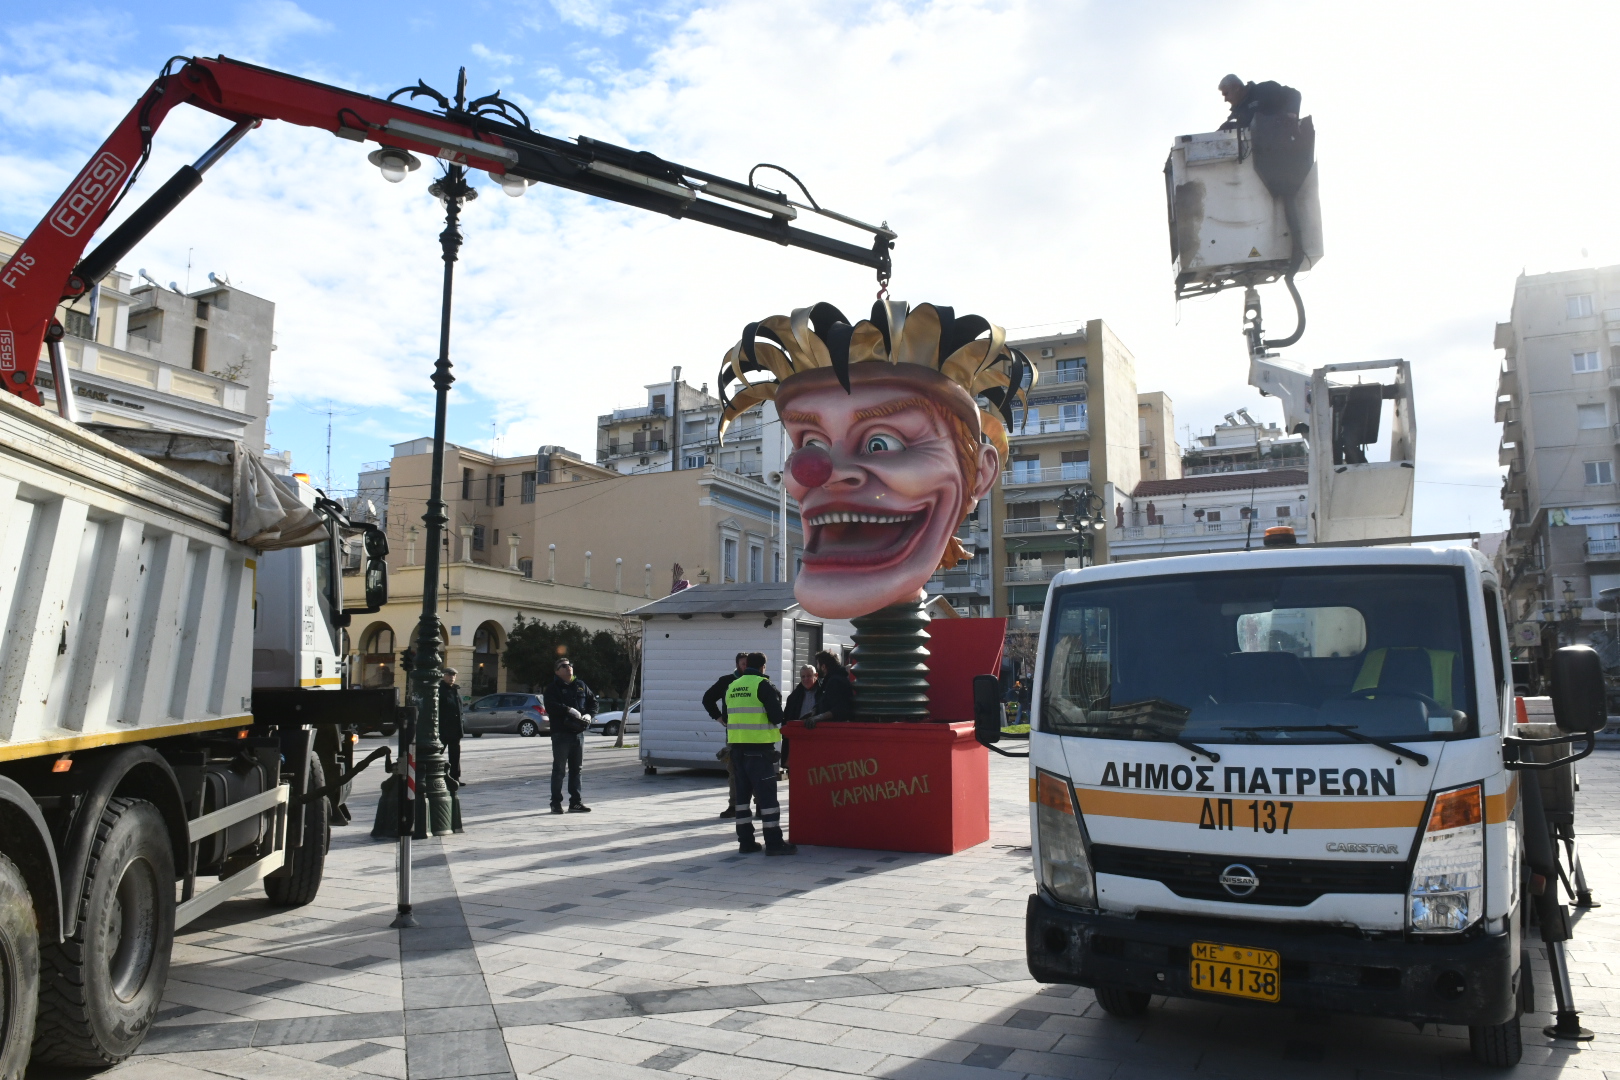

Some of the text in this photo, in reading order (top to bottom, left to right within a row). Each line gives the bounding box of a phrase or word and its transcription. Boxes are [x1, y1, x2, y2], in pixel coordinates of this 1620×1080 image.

[56, 157, 122, 231] FASSI
[2, 252, 36, 289] F115
[0, 333, 13, 368] FASSI
[77, 386, 109, 402] BANK
[807, 757, 878, 785] ΠΑΤΡΙΝΟ
[1100, 761, 1396, 796] ΔΗΜΟΣ ΠΑΤΡΕΩΝ
[831, 774, 931, 808] ΚΑΡΝΑΒΑΛΙ
[1199, 797, 1294, 835] ΔΠ 137
[1326, 842, 1399, 855] CABSTAR
[1222, 877, 1255, 885] NISSAN
[1195, 962, 1276, 996] 114138
